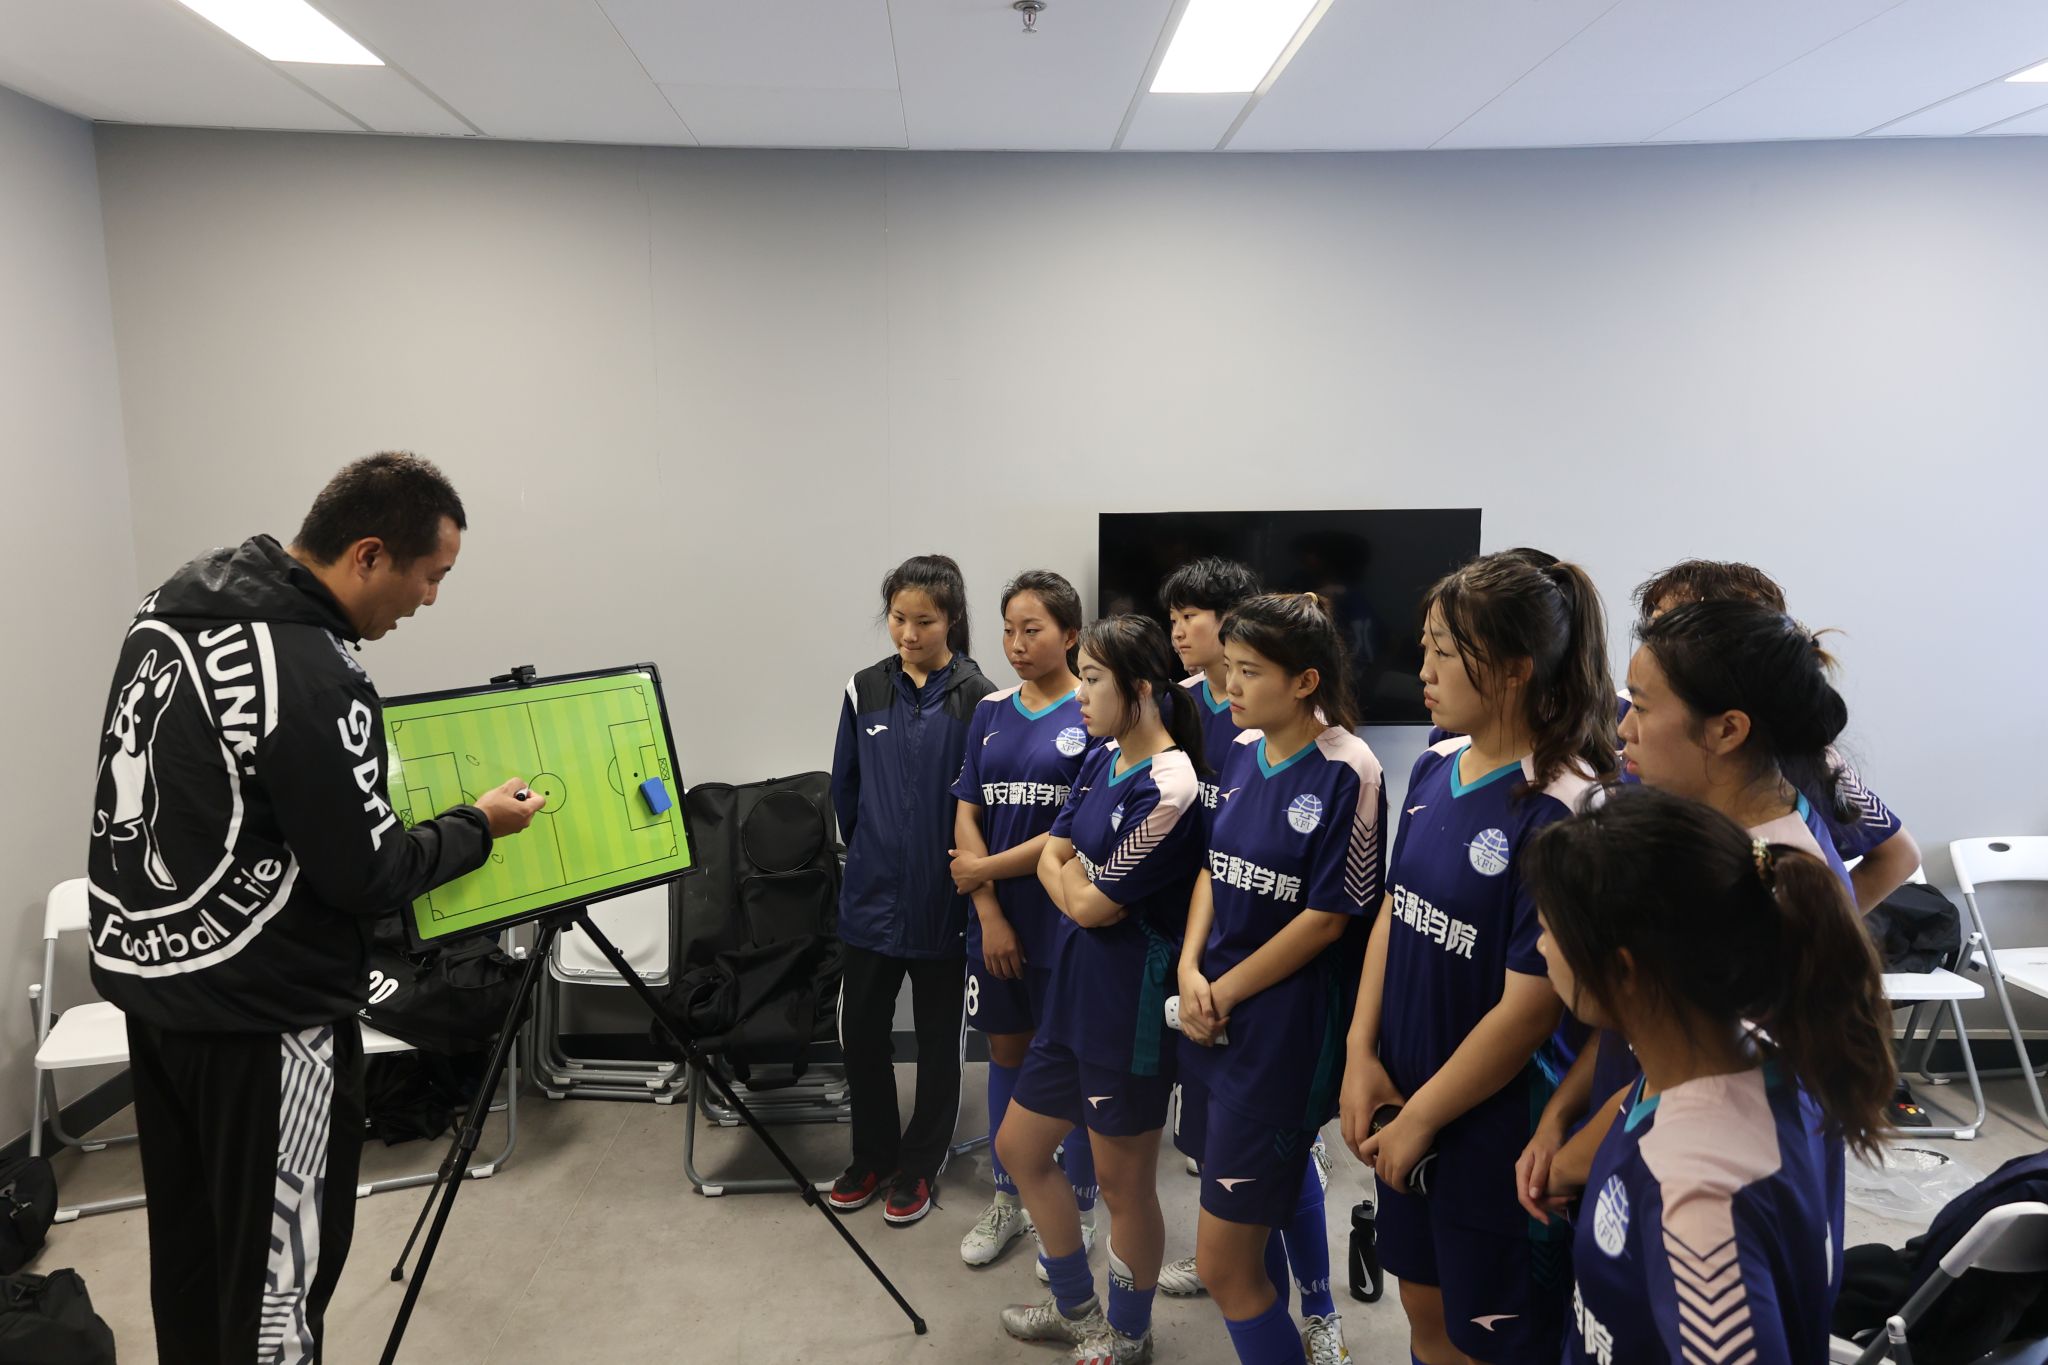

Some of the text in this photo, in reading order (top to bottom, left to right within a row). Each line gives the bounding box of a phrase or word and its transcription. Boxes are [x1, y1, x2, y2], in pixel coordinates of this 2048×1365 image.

[982, 782, 1071, 807] 西安翻译学院
[1208, 849, 1302, 903] 安翻译学院
[1474, 854, 1497, 872] XFU
[96, 908, 231, 962] Football
